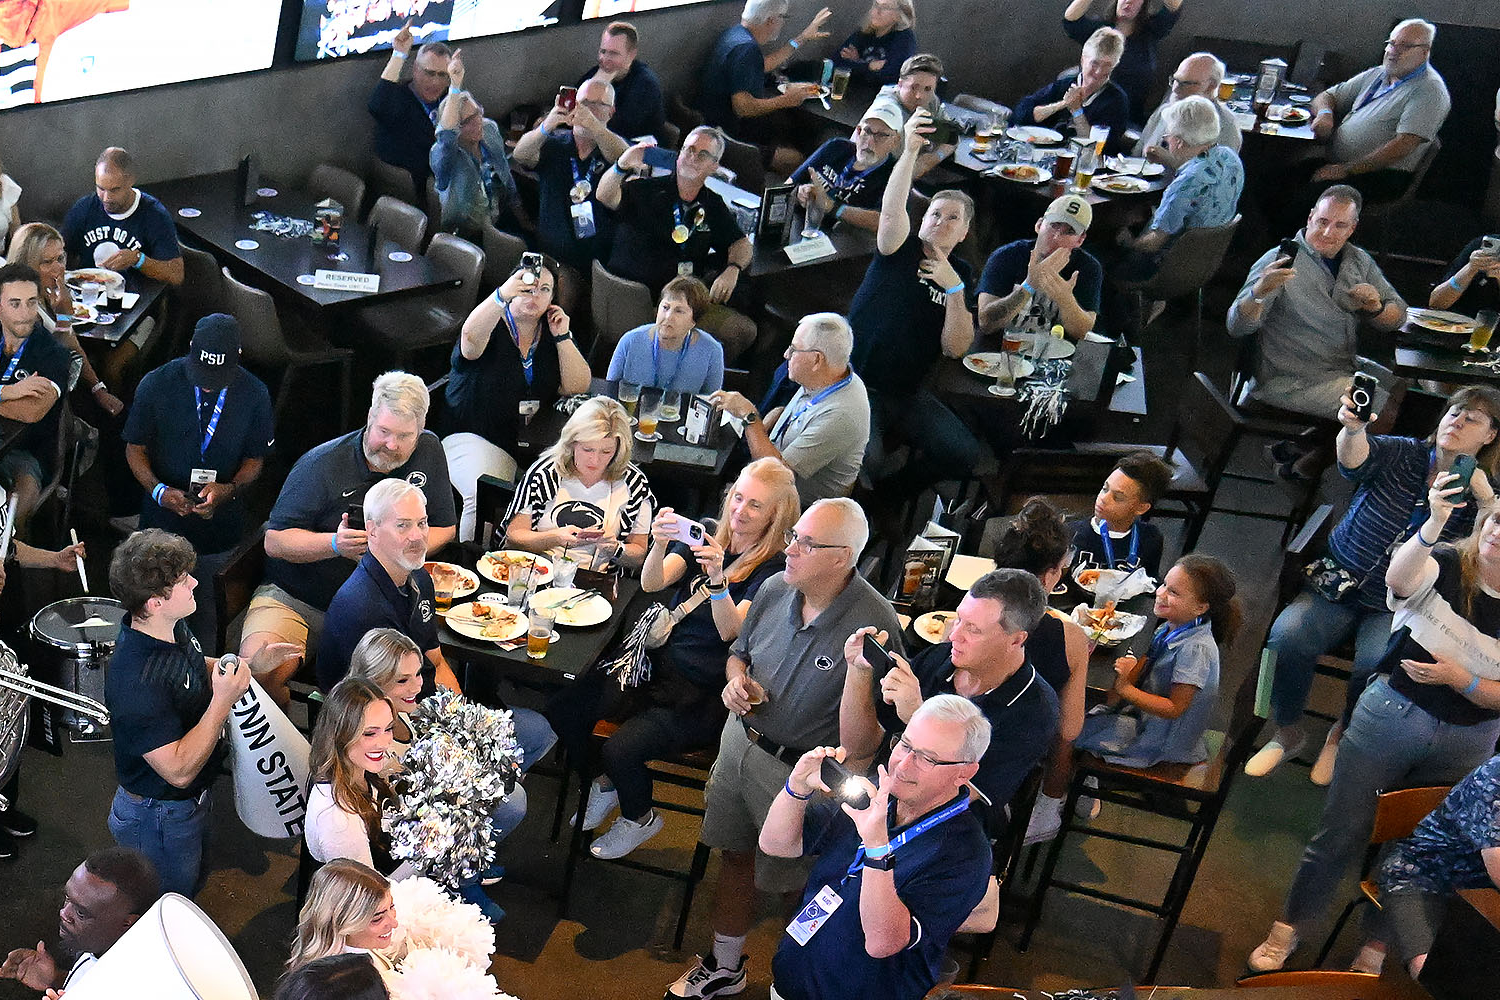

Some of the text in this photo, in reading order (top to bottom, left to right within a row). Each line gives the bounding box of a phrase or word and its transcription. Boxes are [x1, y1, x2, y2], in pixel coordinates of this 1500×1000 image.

[84, 226, 142, 251] JUST DO IT
[325, 273, 370, 283] RESERVED
[200, 350, 226, 366] PSU
[256, 750, 307, 837] STATE
